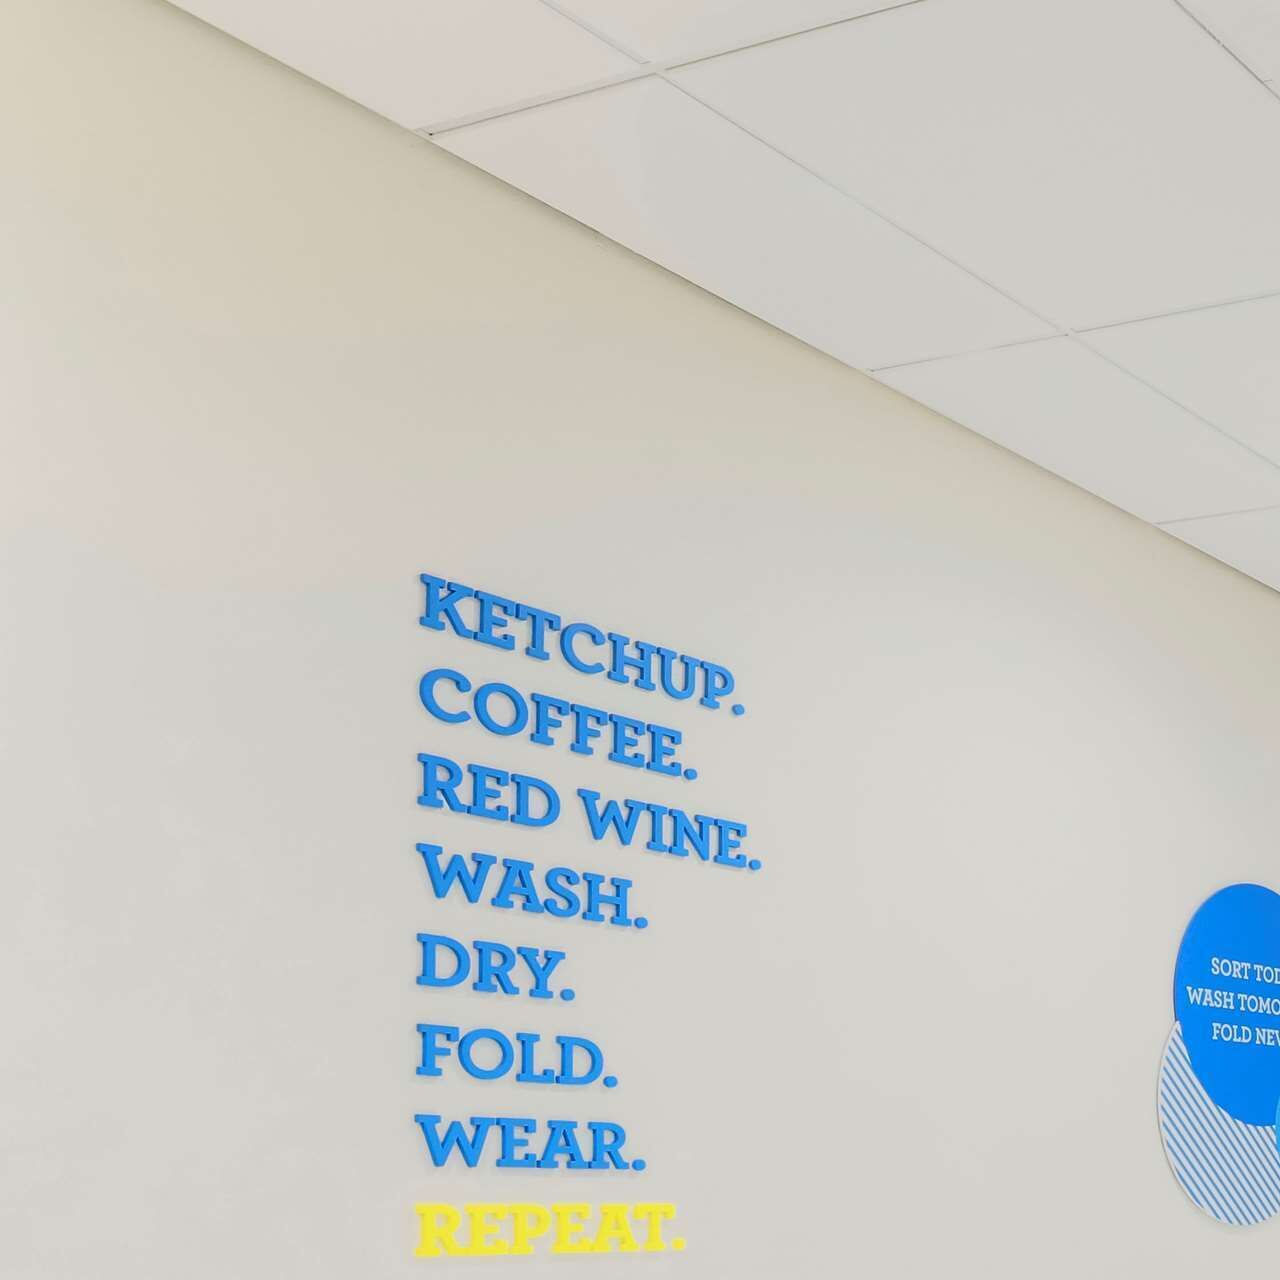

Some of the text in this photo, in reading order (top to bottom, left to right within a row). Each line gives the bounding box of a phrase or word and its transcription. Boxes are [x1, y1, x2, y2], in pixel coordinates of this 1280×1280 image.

[419, 573, 745, 716] KETCHUP.
[418, 668, 698, 781] COFFEE.
[416, 752, 763, 872] RED WINE.
[415, 842, 649, 929] WASH.
[416, 932, 576, 1001] DRY.
[1186, 985, 1235, 1010] WASH
[1210, 957, 1252, 982] SORT
[415, 1023, 618, 1088] FOLD.
[1211, 1022, 1252, 1045] FOLD
[414, 1113, 647, 1172] WEAR.
[414, 1203, 686, 1258] REPEAT.
